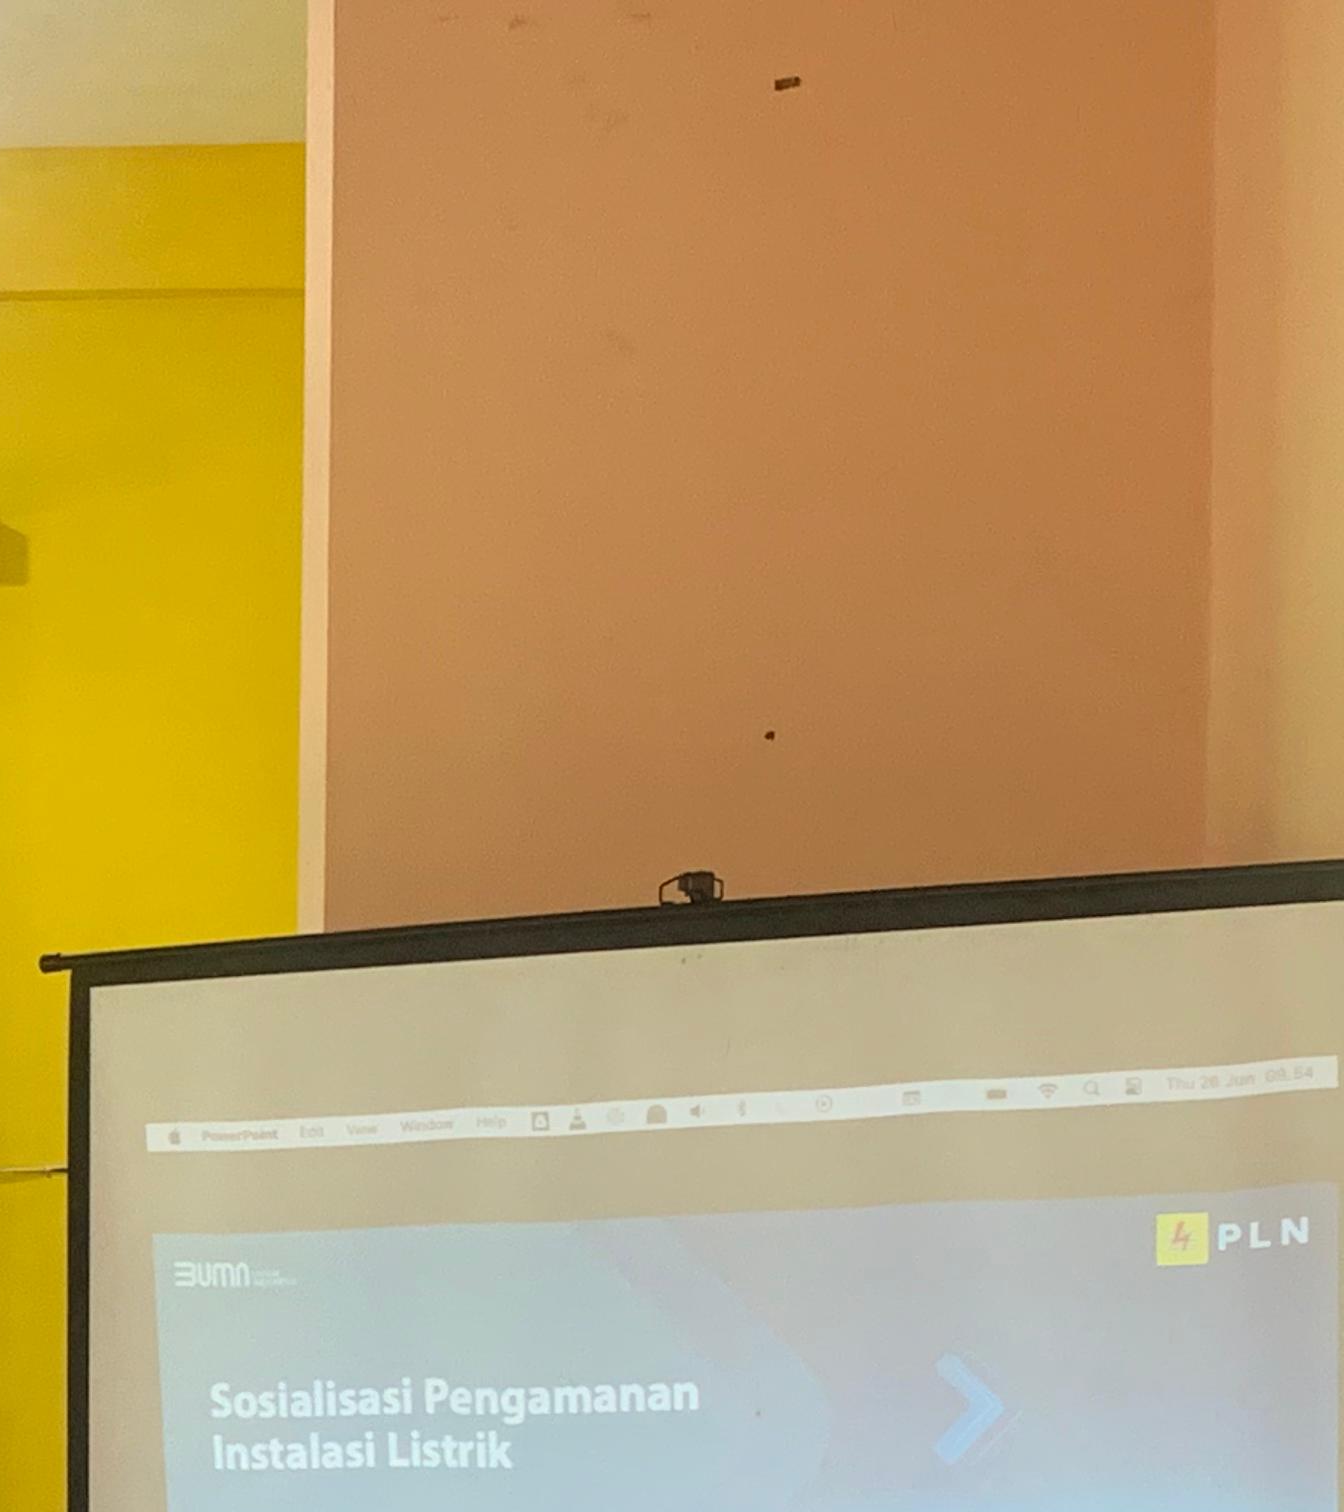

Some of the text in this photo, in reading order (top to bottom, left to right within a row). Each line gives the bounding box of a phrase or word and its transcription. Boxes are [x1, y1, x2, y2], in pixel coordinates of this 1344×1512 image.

[202, 1129, 279, 1142] PowerPoint
[400, 1118, 454, 1133] Window
[476, 1114, 508, 1129] Help
[1218, 1216, 1310, 1251] PLN
[210, 1378, 700, 1424] Sosialisasi Pengamanan
[212, 1431, 512, 1470] Instalasi Listrik
